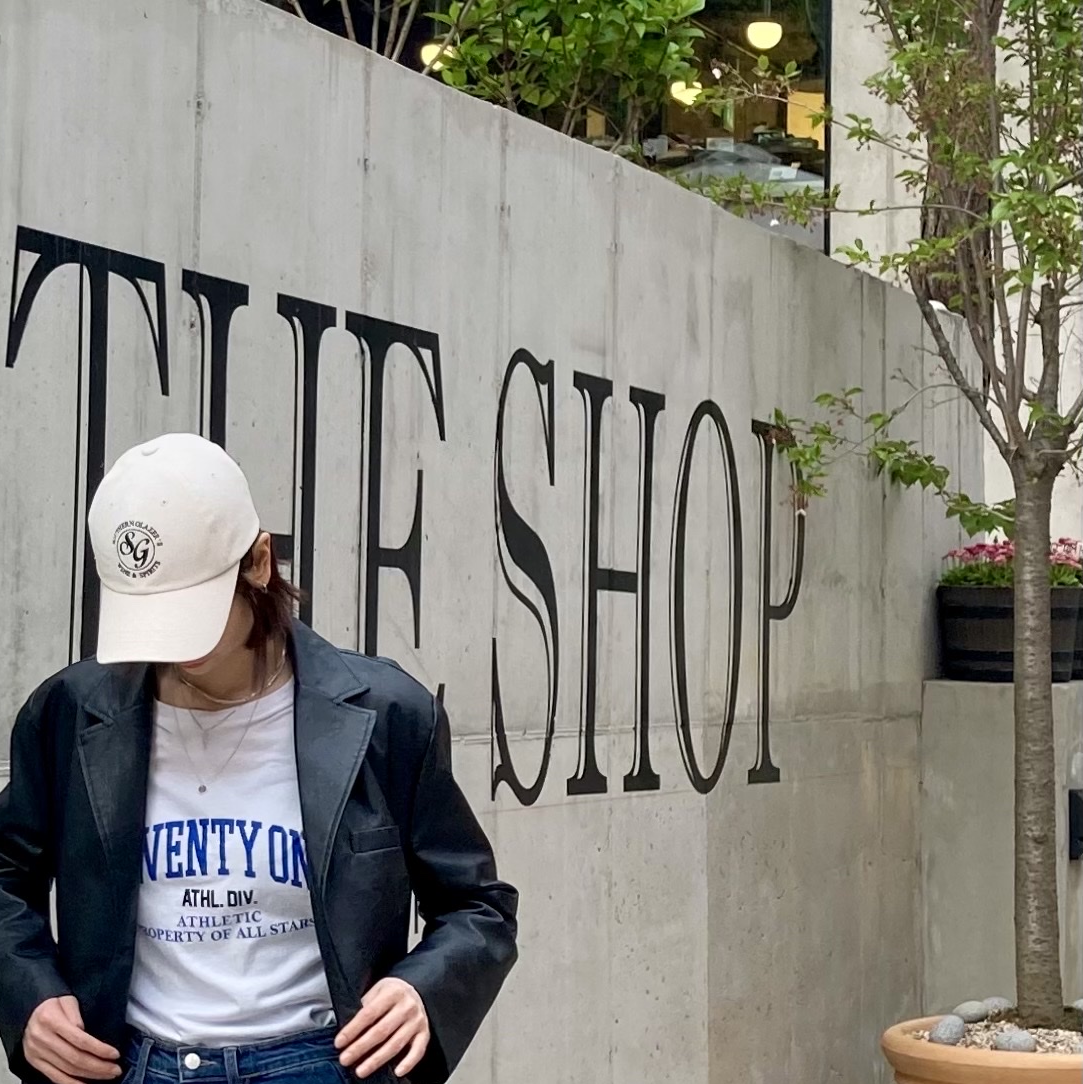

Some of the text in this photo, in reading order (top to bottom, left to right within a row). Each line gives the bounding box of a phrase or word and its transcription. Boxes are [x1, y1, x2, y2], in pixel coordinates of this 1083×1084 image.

[119, 531, 150, 569] SG
[492, 347, 805, 806] SHOP
[182, 889, 258, 908] ATHL. DIV.
[177, 910, 262, 928] ATHLETIC
[139, 925, 206, 942] ROPERTY
[211, 929, 230, 941] OF
[236, 926, 266, 939] ALL
